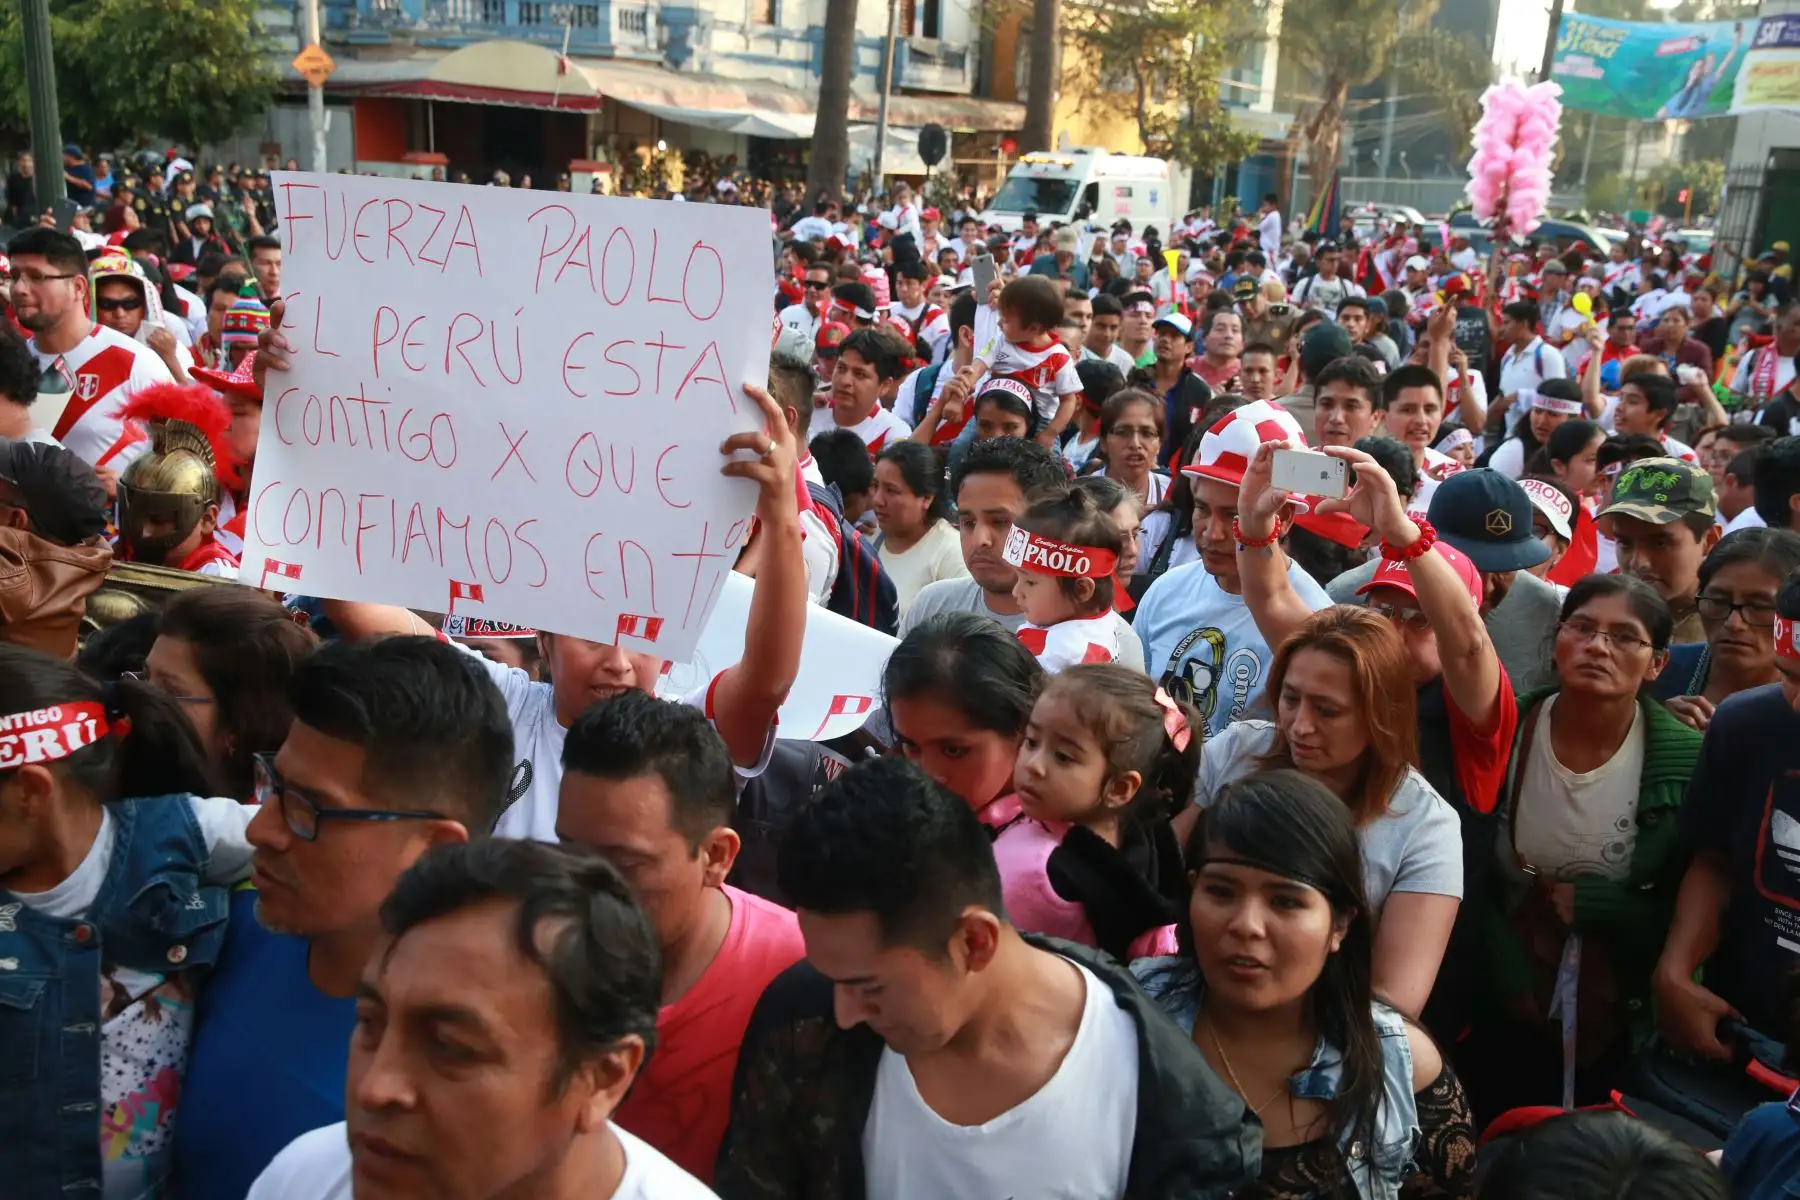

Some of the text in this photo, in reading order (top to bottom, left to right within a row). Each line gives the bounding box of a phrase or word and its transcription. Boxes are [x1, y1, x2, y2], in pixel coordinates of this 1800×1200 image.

[1757, 21, 1786, 45] SAT
[280, 182, 724, 321] FUERZA PAOLO
[372, 306, 524, 388] PERÚ
[562, 330, 738, 414] ESTA
[1003, 379, 1032, 402] PAOLO
[490, 421, 536, 483] X
[565, 431, 692, 508] QUE
[1523, 480, 1570, 516] PAOLO
[1023, 543, 1091, 575] PAOLO
[467, 617, 532, 633] PAO
[0, 706, 63, 732] NTIGO
[0, 711, 97, 768] ERÚ
